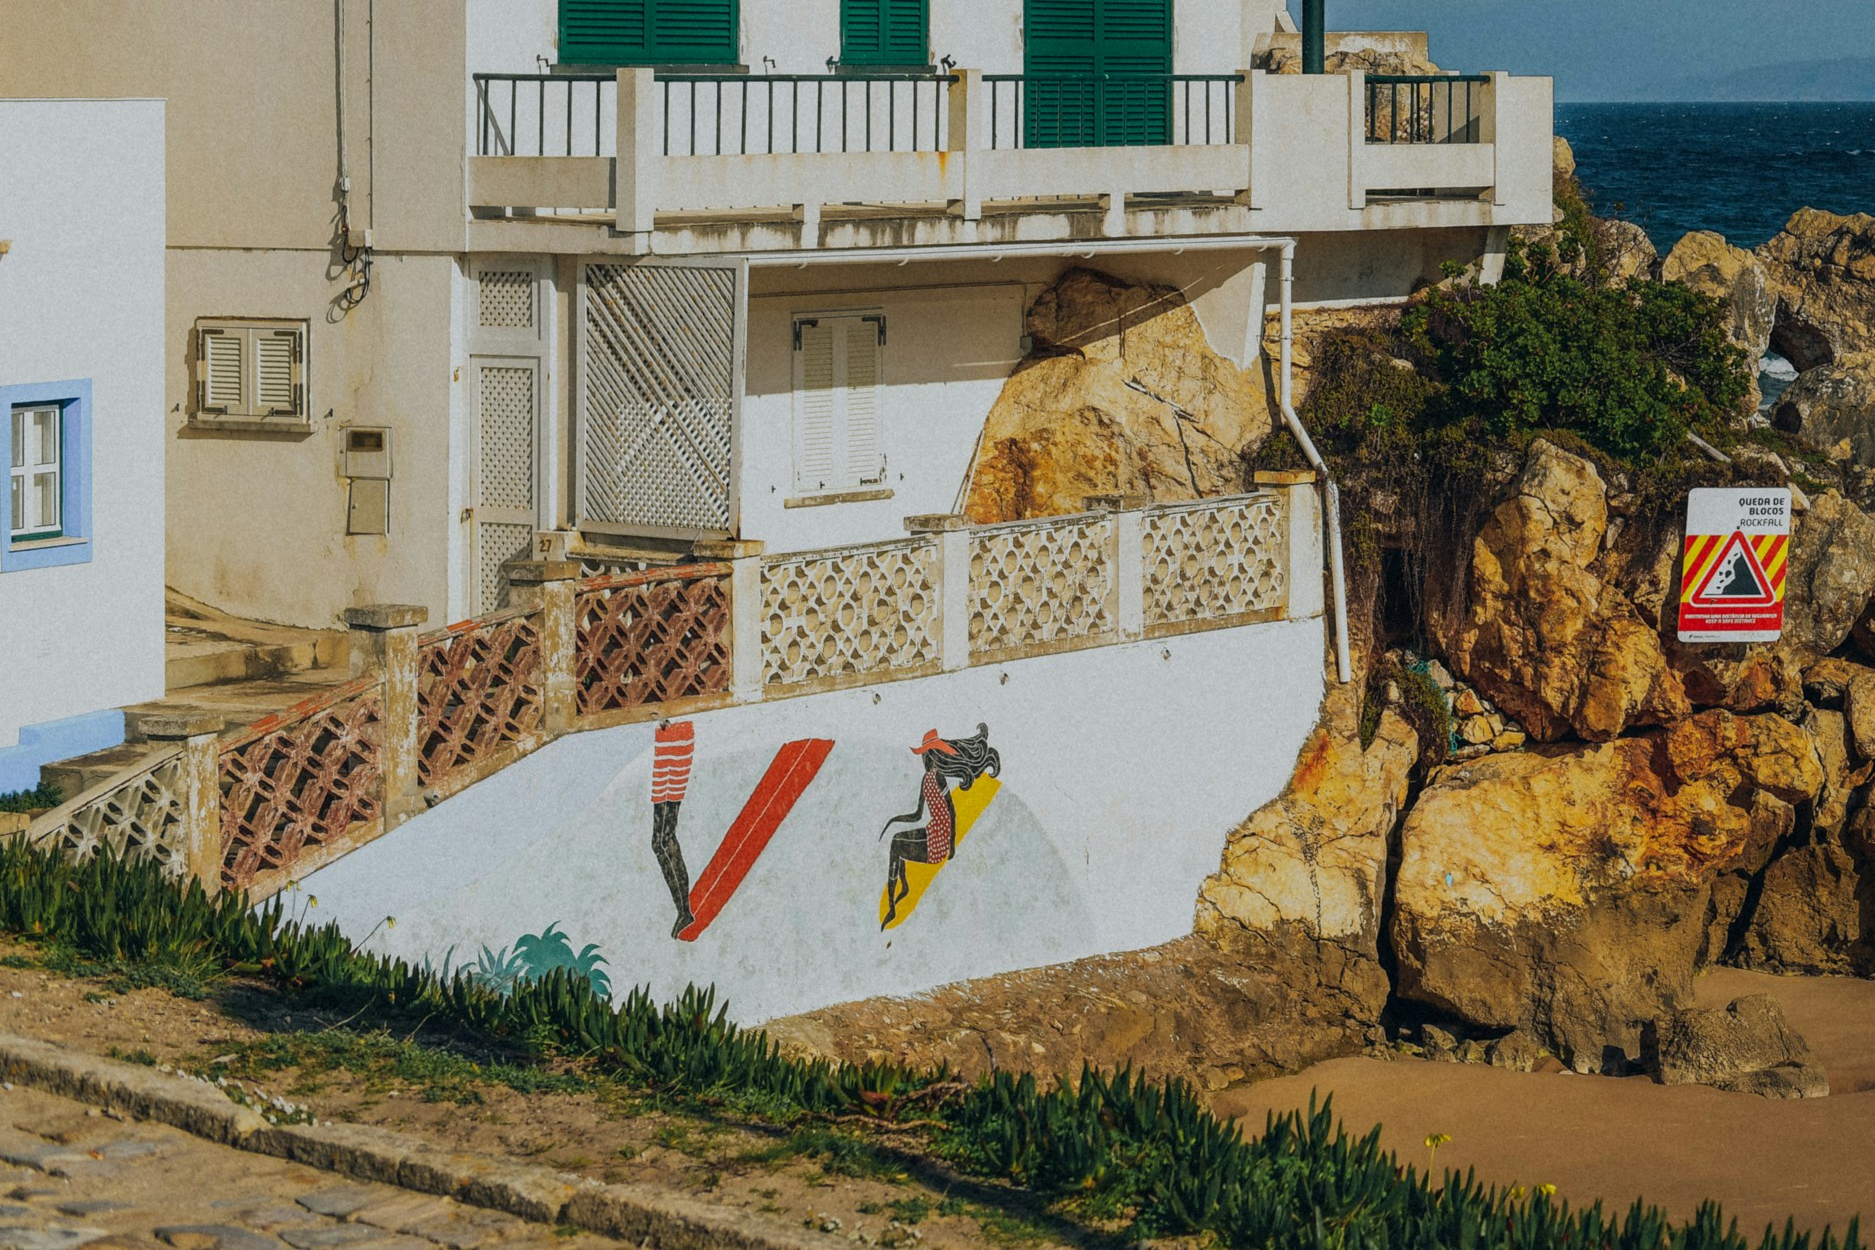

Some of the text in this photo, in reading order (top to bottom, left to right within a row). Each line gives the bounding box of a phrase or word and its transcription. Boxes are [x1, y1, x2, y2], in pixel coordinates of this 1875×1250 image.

[1739, 498, 1785, 507] QUEDA DE
[1749, 507, 1784, 515] BLOCOS
[539, 539, 552, 552] 27
